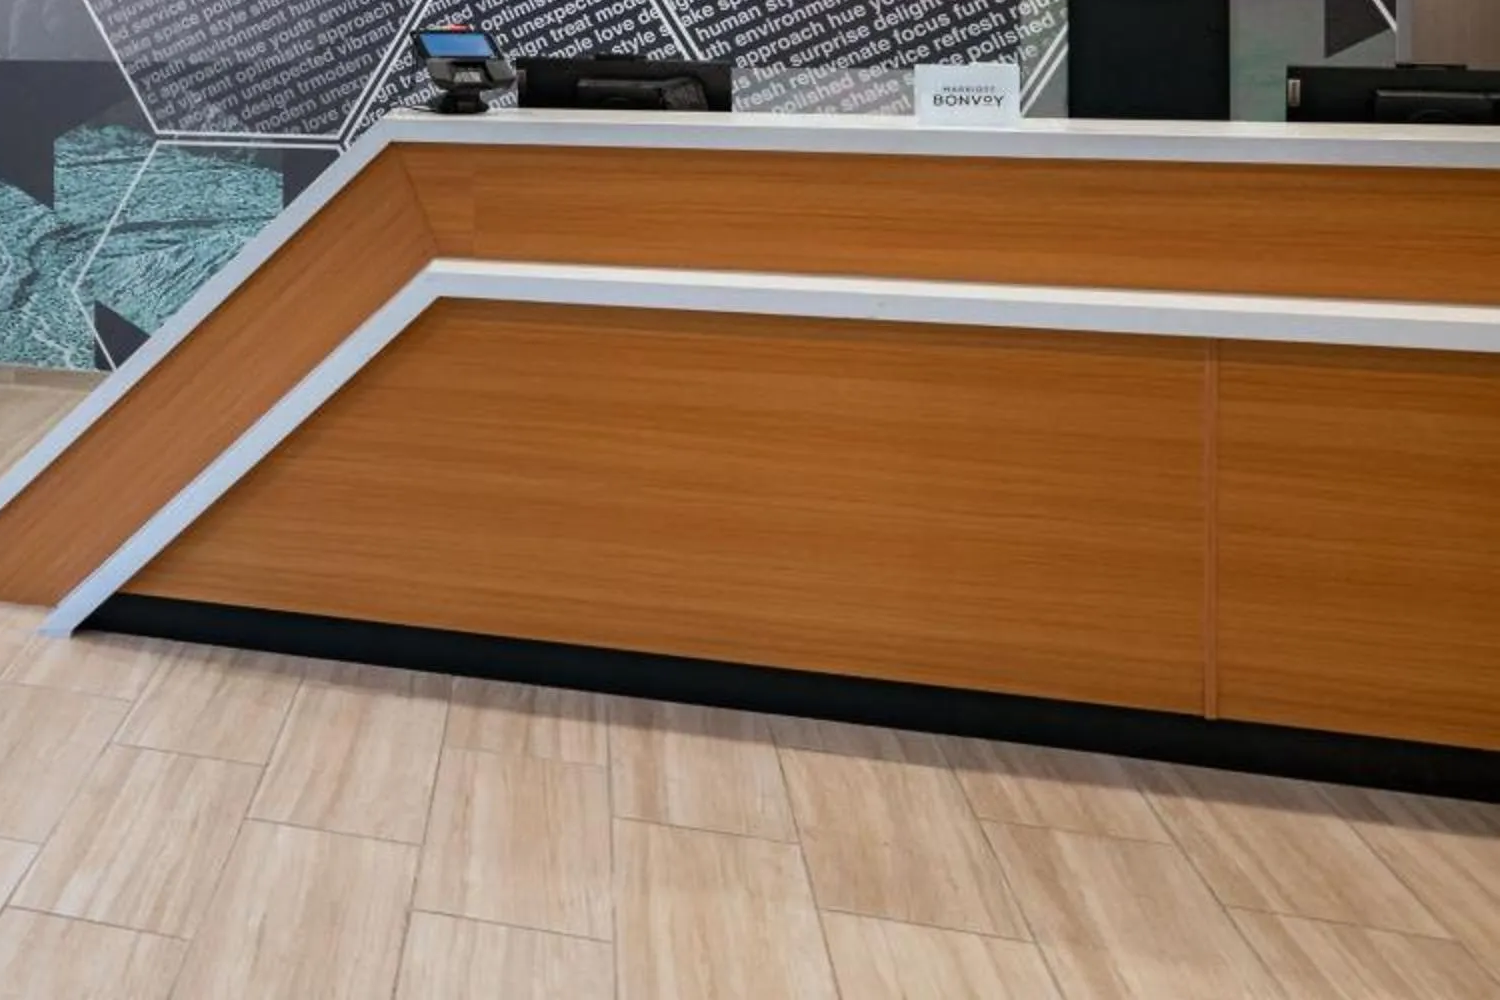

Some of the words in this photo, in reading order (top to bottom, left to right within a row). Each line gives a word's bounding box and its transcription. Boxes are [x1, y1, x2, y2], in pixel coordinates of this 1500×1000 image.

[131, 0, 186, 33] service
[151, 29, 206, 61] human
[209, 10, 247, 35] style
[153, 13, 199, 42] space
[187, 10, 287, 64] environment
[549, 13, 593, 42] treat
[593, 19, 634, 43] love
[695, 5, 761, 41] human
[735, 21, 825, 68] approach
[826, 4, 866, 28] hue
[160, 56, 233, 97] approach
[233, 41, 266, 62] hue
[268, 18, 315, 50] youth
[177, 75, 232, 108] vibrant
[235, 39, 314, 82] optimistic
[316, 1, 394, 44] approach
[611, 30, 656, 55] style
[752, 61, 787, 81] fun
[788, 25, 870, 66] surprise
[789, 38, 890, 88] rejuvenate
[892, 12, 950, 44] focus
[841, 79, 899, 111] shake
[966, 11, 1055, 61] polished
[857, 44, 929, 81] service
[932, 11, 1005, 50] refresh
[240, 47, 334, 99] unexpected
[241, 88, 295, 119] design
[296, 52, 372, 94] trmodern
[256, 98, 316, 138] modern
[302, 108, 338, 130] love
[932, 94, 1005, 108] BONVOY
